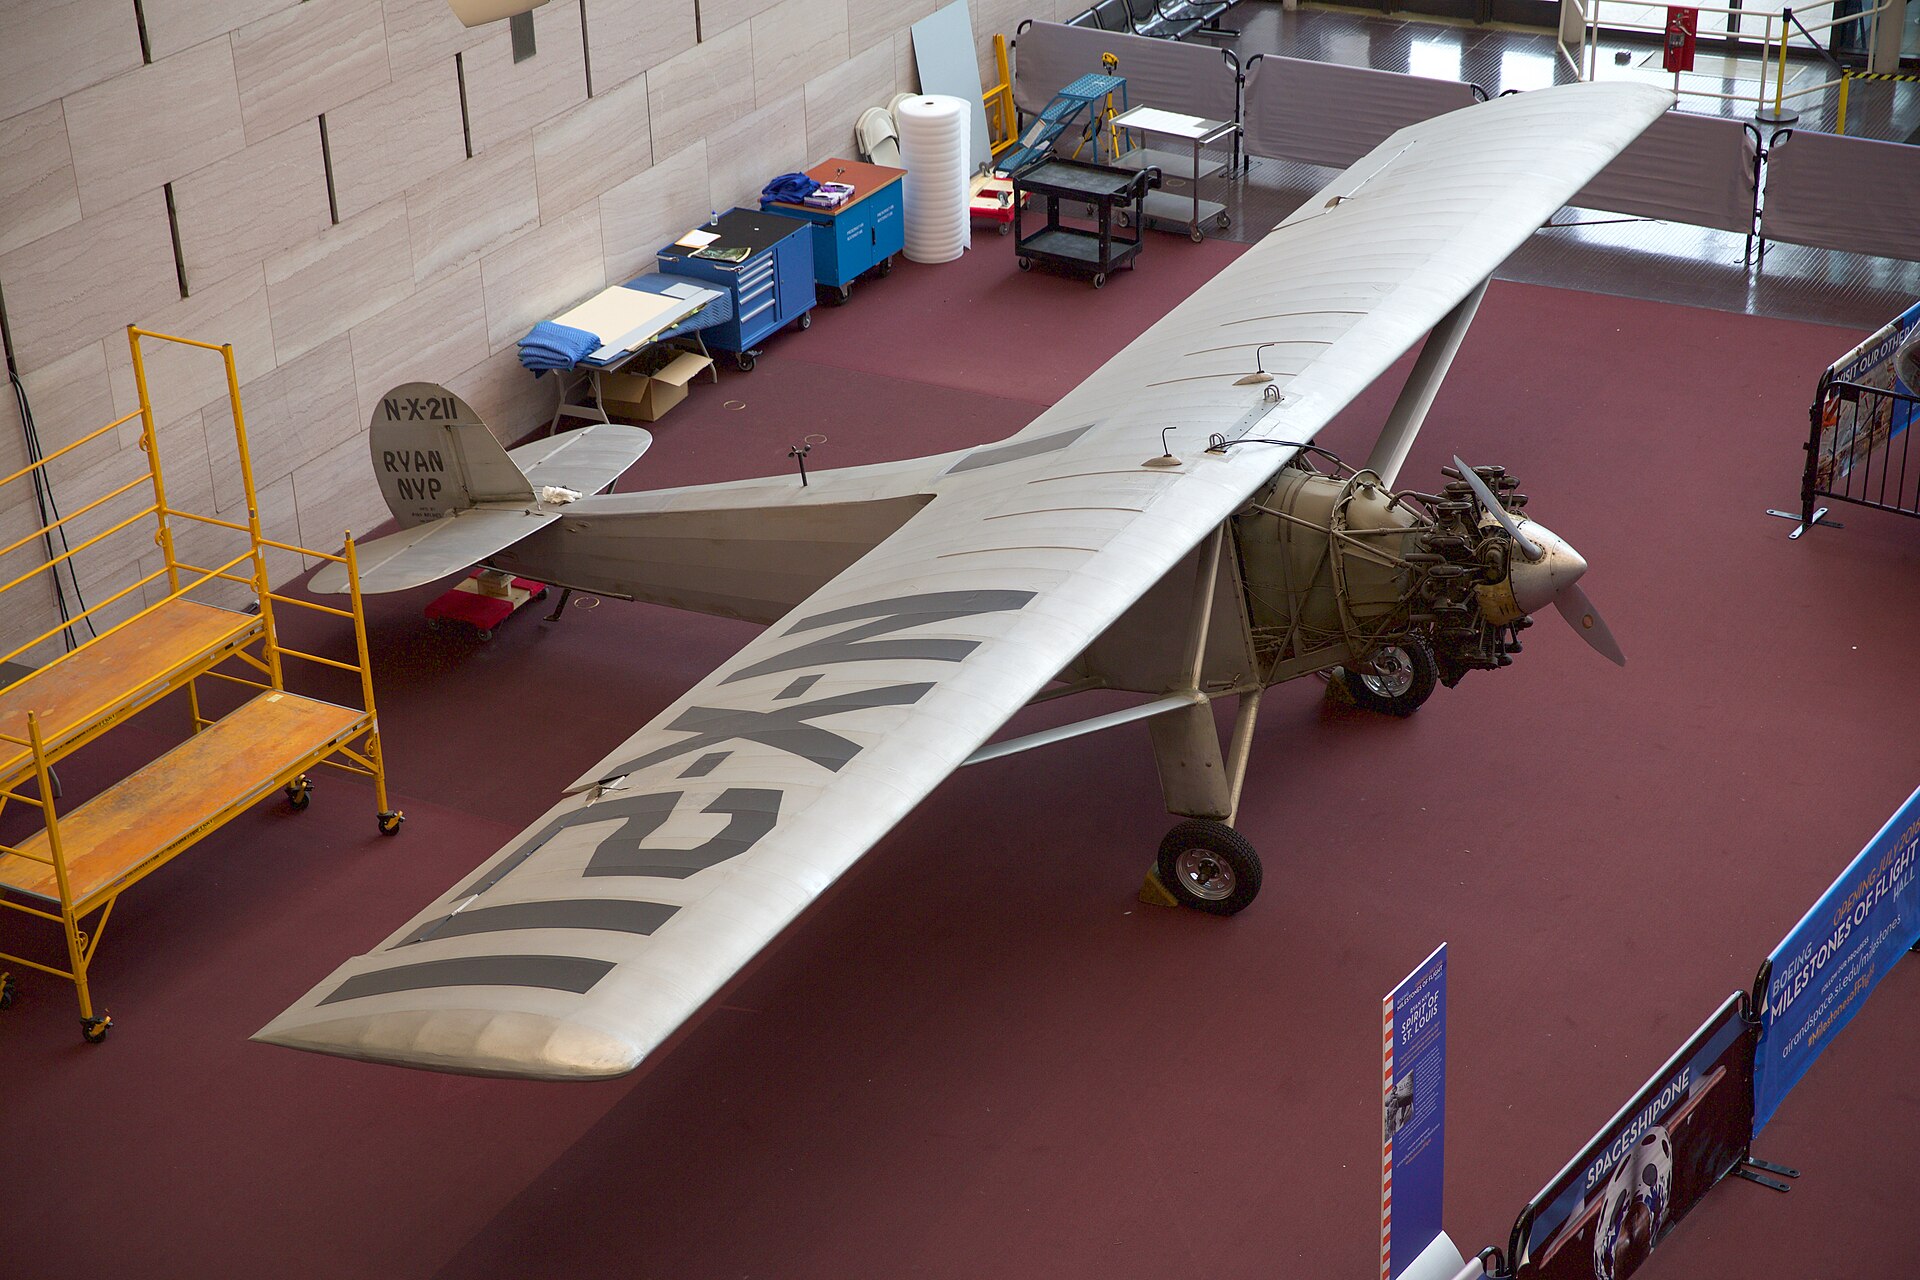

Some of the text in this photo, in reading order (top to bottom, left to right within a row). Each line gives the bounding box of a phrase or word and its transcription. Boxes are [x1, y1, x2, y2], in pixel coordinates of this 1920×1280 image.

[1860, 348, 1880, 372] OUR
[383, 397, 458, 421] N-X-211
[383, 450, 444, 473] RYAN
[397, 478, 442, 500] NYP
[1833, 868, 1877, 926] OPENING
[1877, 841, 1899, 877] JULY
[1893, 866, 1915, 903] HALL
[1771, 838, 1919, 1026] MILESTONES OF FLIGHT
[1772, 942, 1812, 997] BOEING
[1401, 1003, 1427, 1034] SPIRIT
[1428, 990, 1439, 1008] OF
[1402, 1004, 1438, 1045] ST. LOUIS
[1586, 1066, 1690, 1189] SPACESHIPONE
